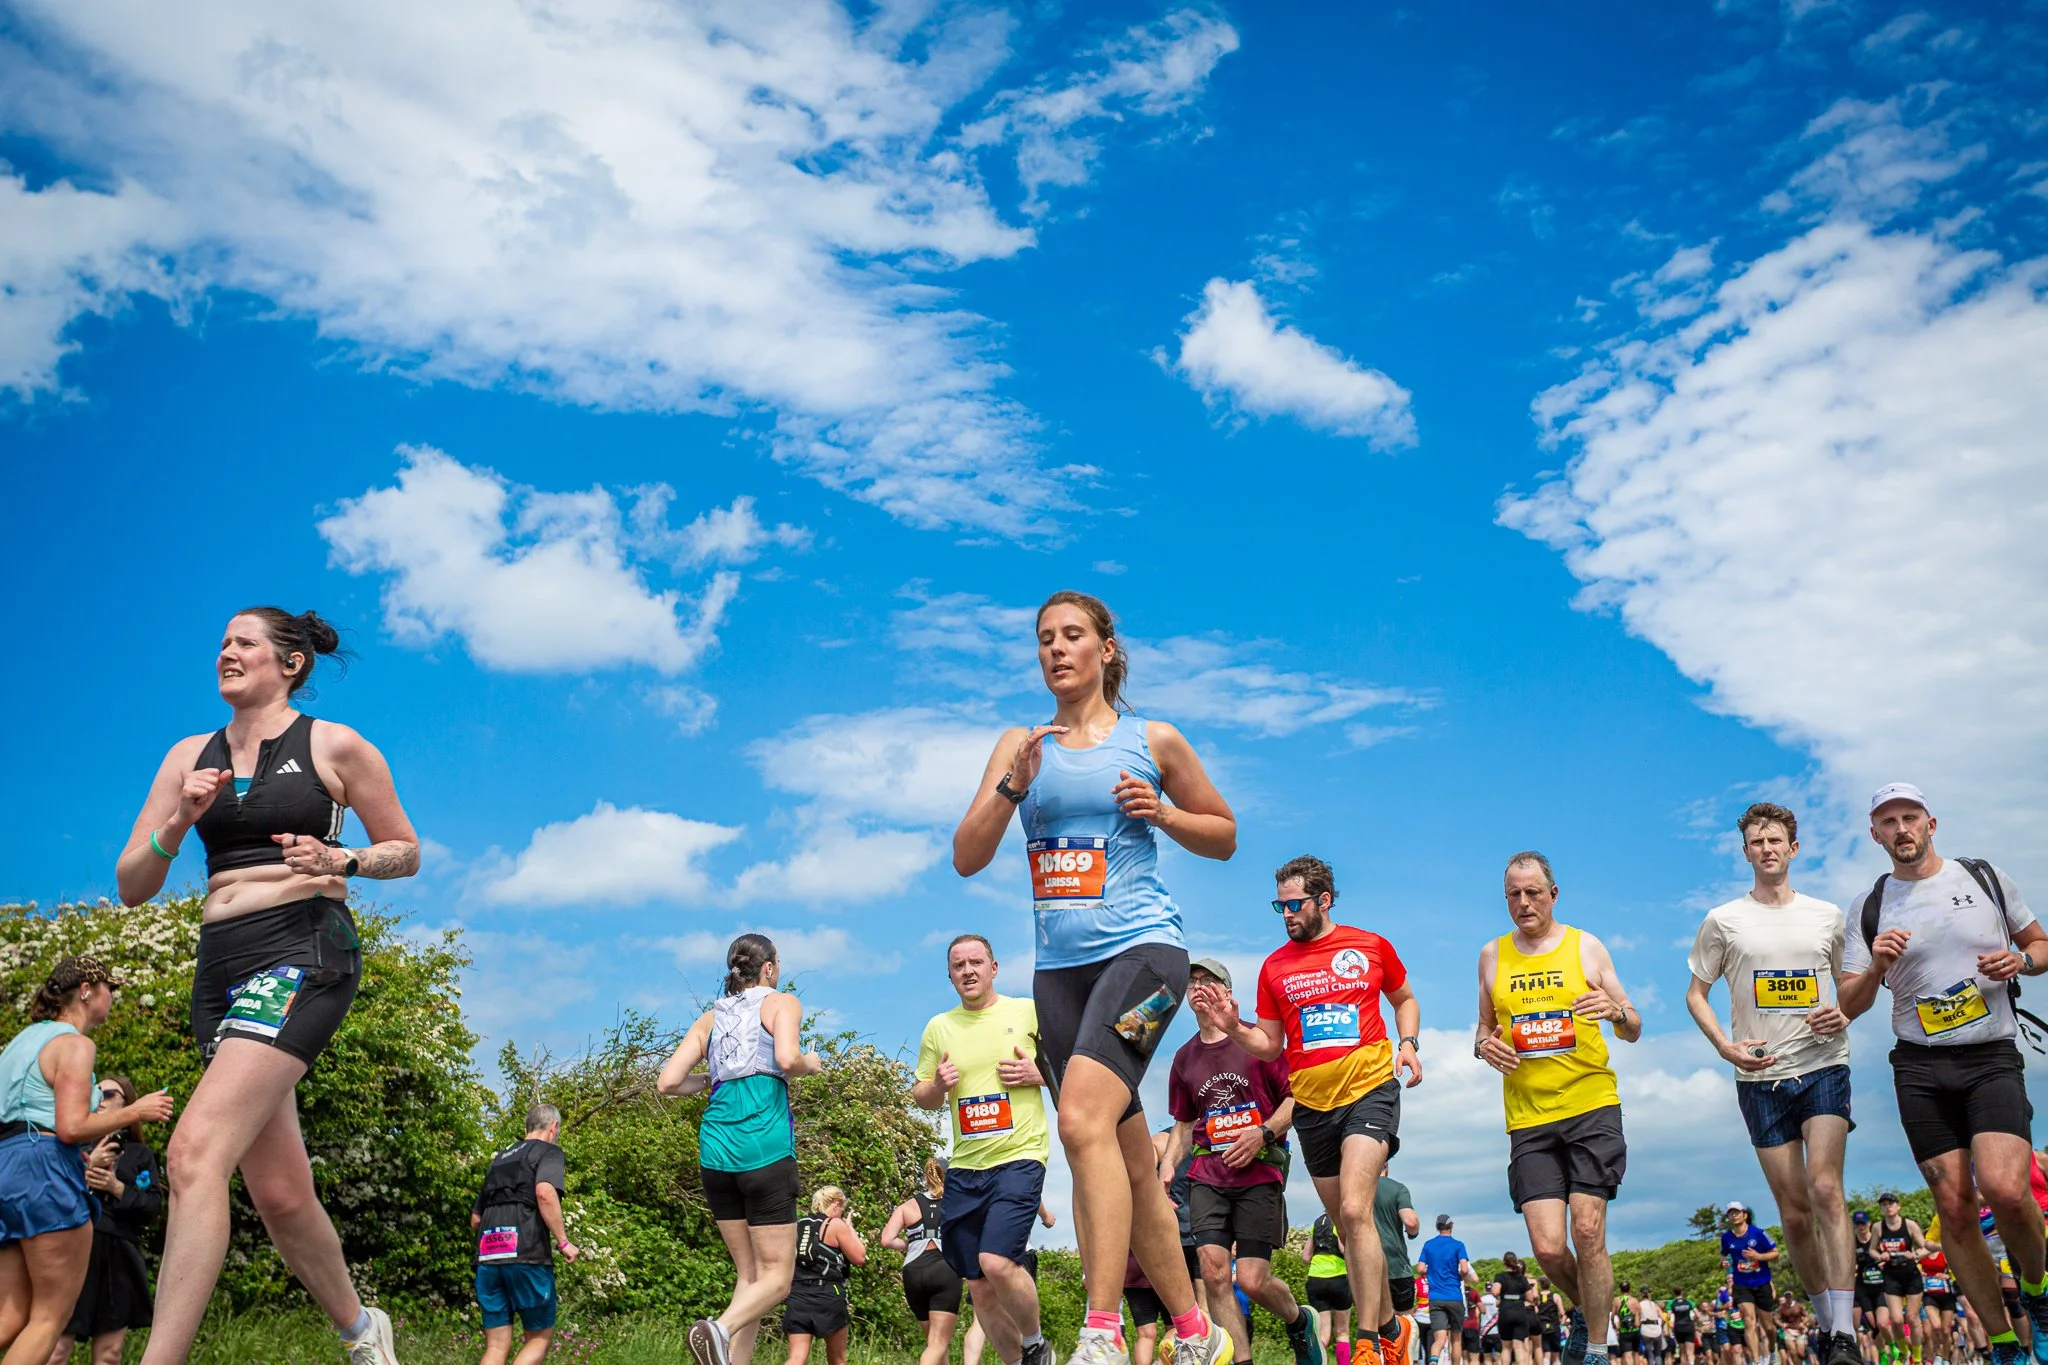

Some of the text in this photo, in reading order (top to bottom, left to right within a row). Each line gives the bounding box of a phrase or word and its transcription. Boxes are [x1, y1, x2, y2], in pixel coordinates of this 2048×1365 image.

[1038, 852, 1093, 873] 10169
[1282, 970, 1328, 986] Edinburgh
[1285, 976, 1336, 994] Children's
[1767, 979, 1807, 991] 3810
[1287, 980, 1370, 1002] Hospital Charity
[1521, 995, 1554, 1005] ttp.com
[1305, 1012, 1352, 1027] 22576
[1942, 1009, 1967, 1023] REECE
[1520, 1020, 1564, 1036] 8482
[1527, 1035, 1559, 1045] NATHAN
[1198, 1072, 1249, 1097] THE SAXONS
[965, 1103, 1000, 1119] 9180
[970, 1117, 998, 1127] DARREN
[1214, 1111, 1252, 1130] 9046
